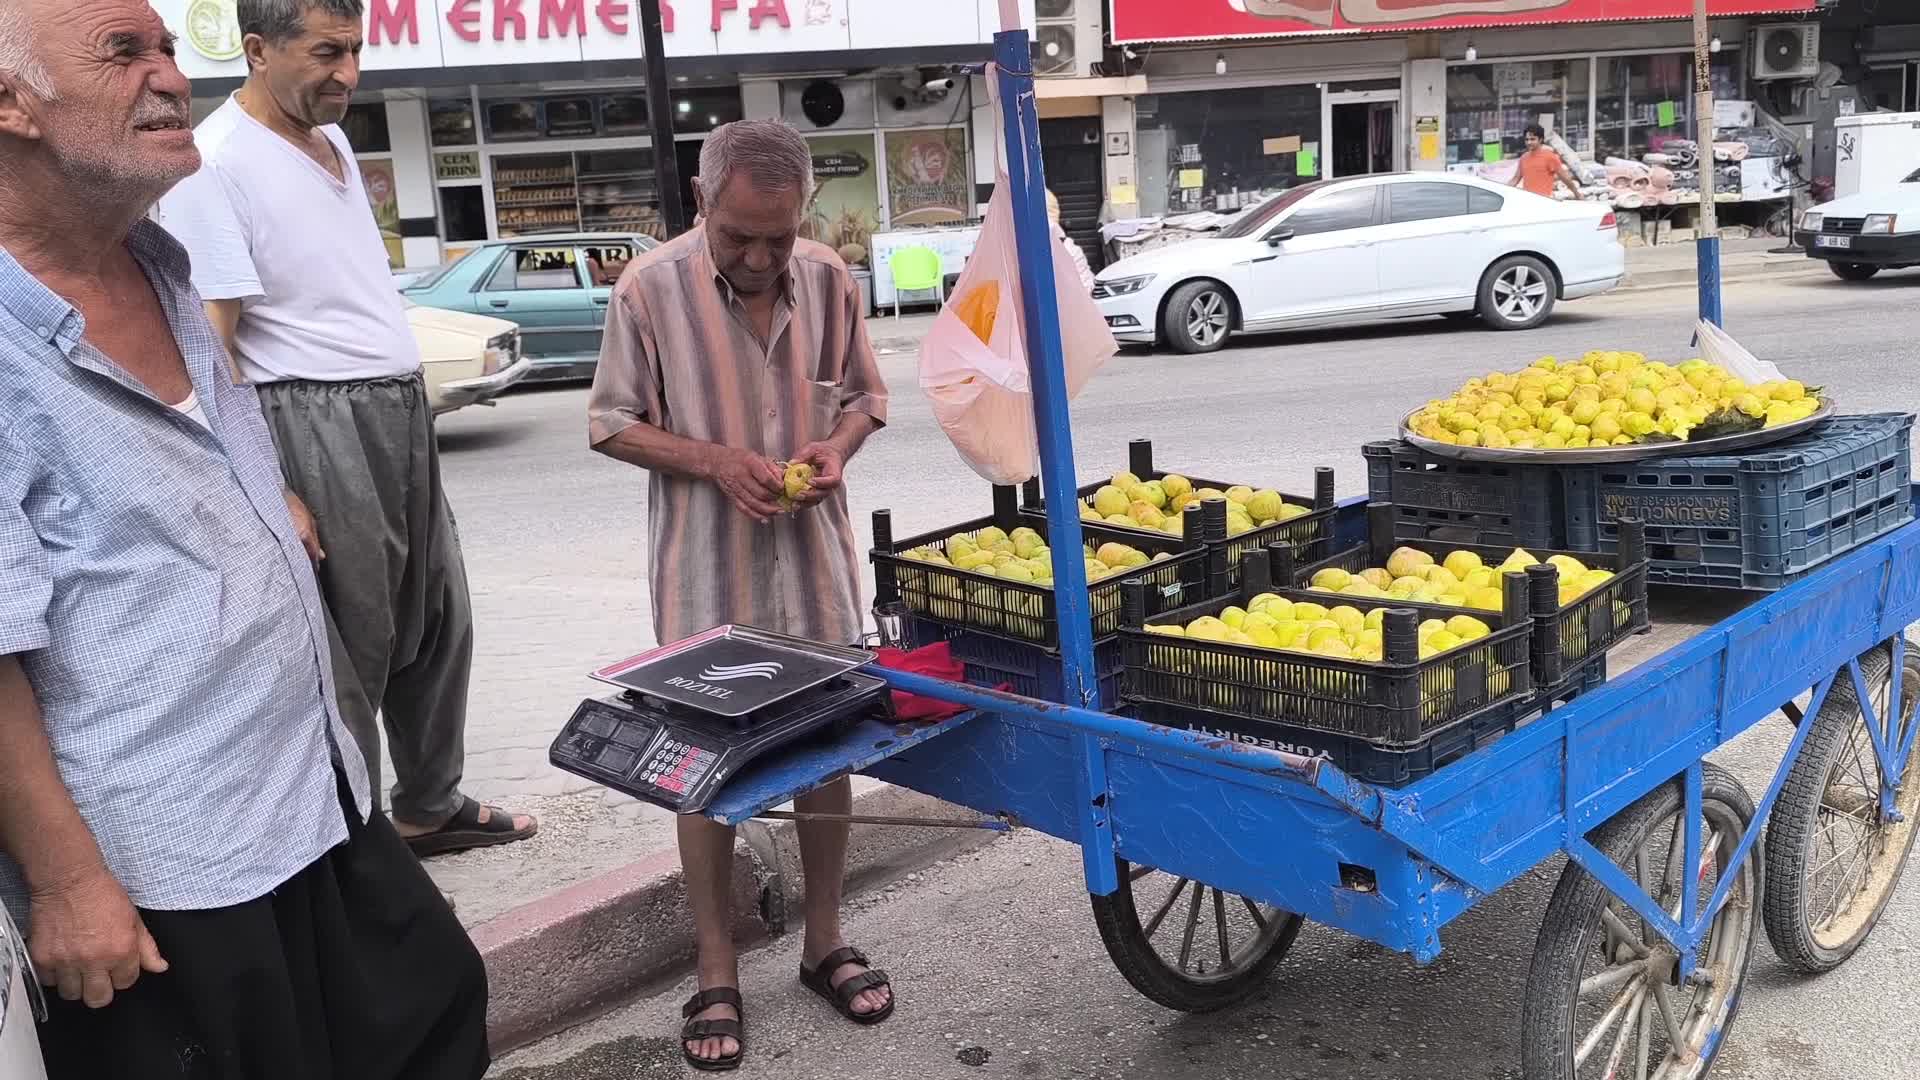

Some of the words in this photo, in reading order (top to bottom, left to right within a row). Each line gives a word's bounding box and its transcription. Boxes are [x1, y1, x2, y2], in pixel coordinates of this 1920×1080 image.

[446, 0, 674, 42] EKME
[442, 155, 470, 165] CEM
[663, 676, 735, 699] BOZYEL
